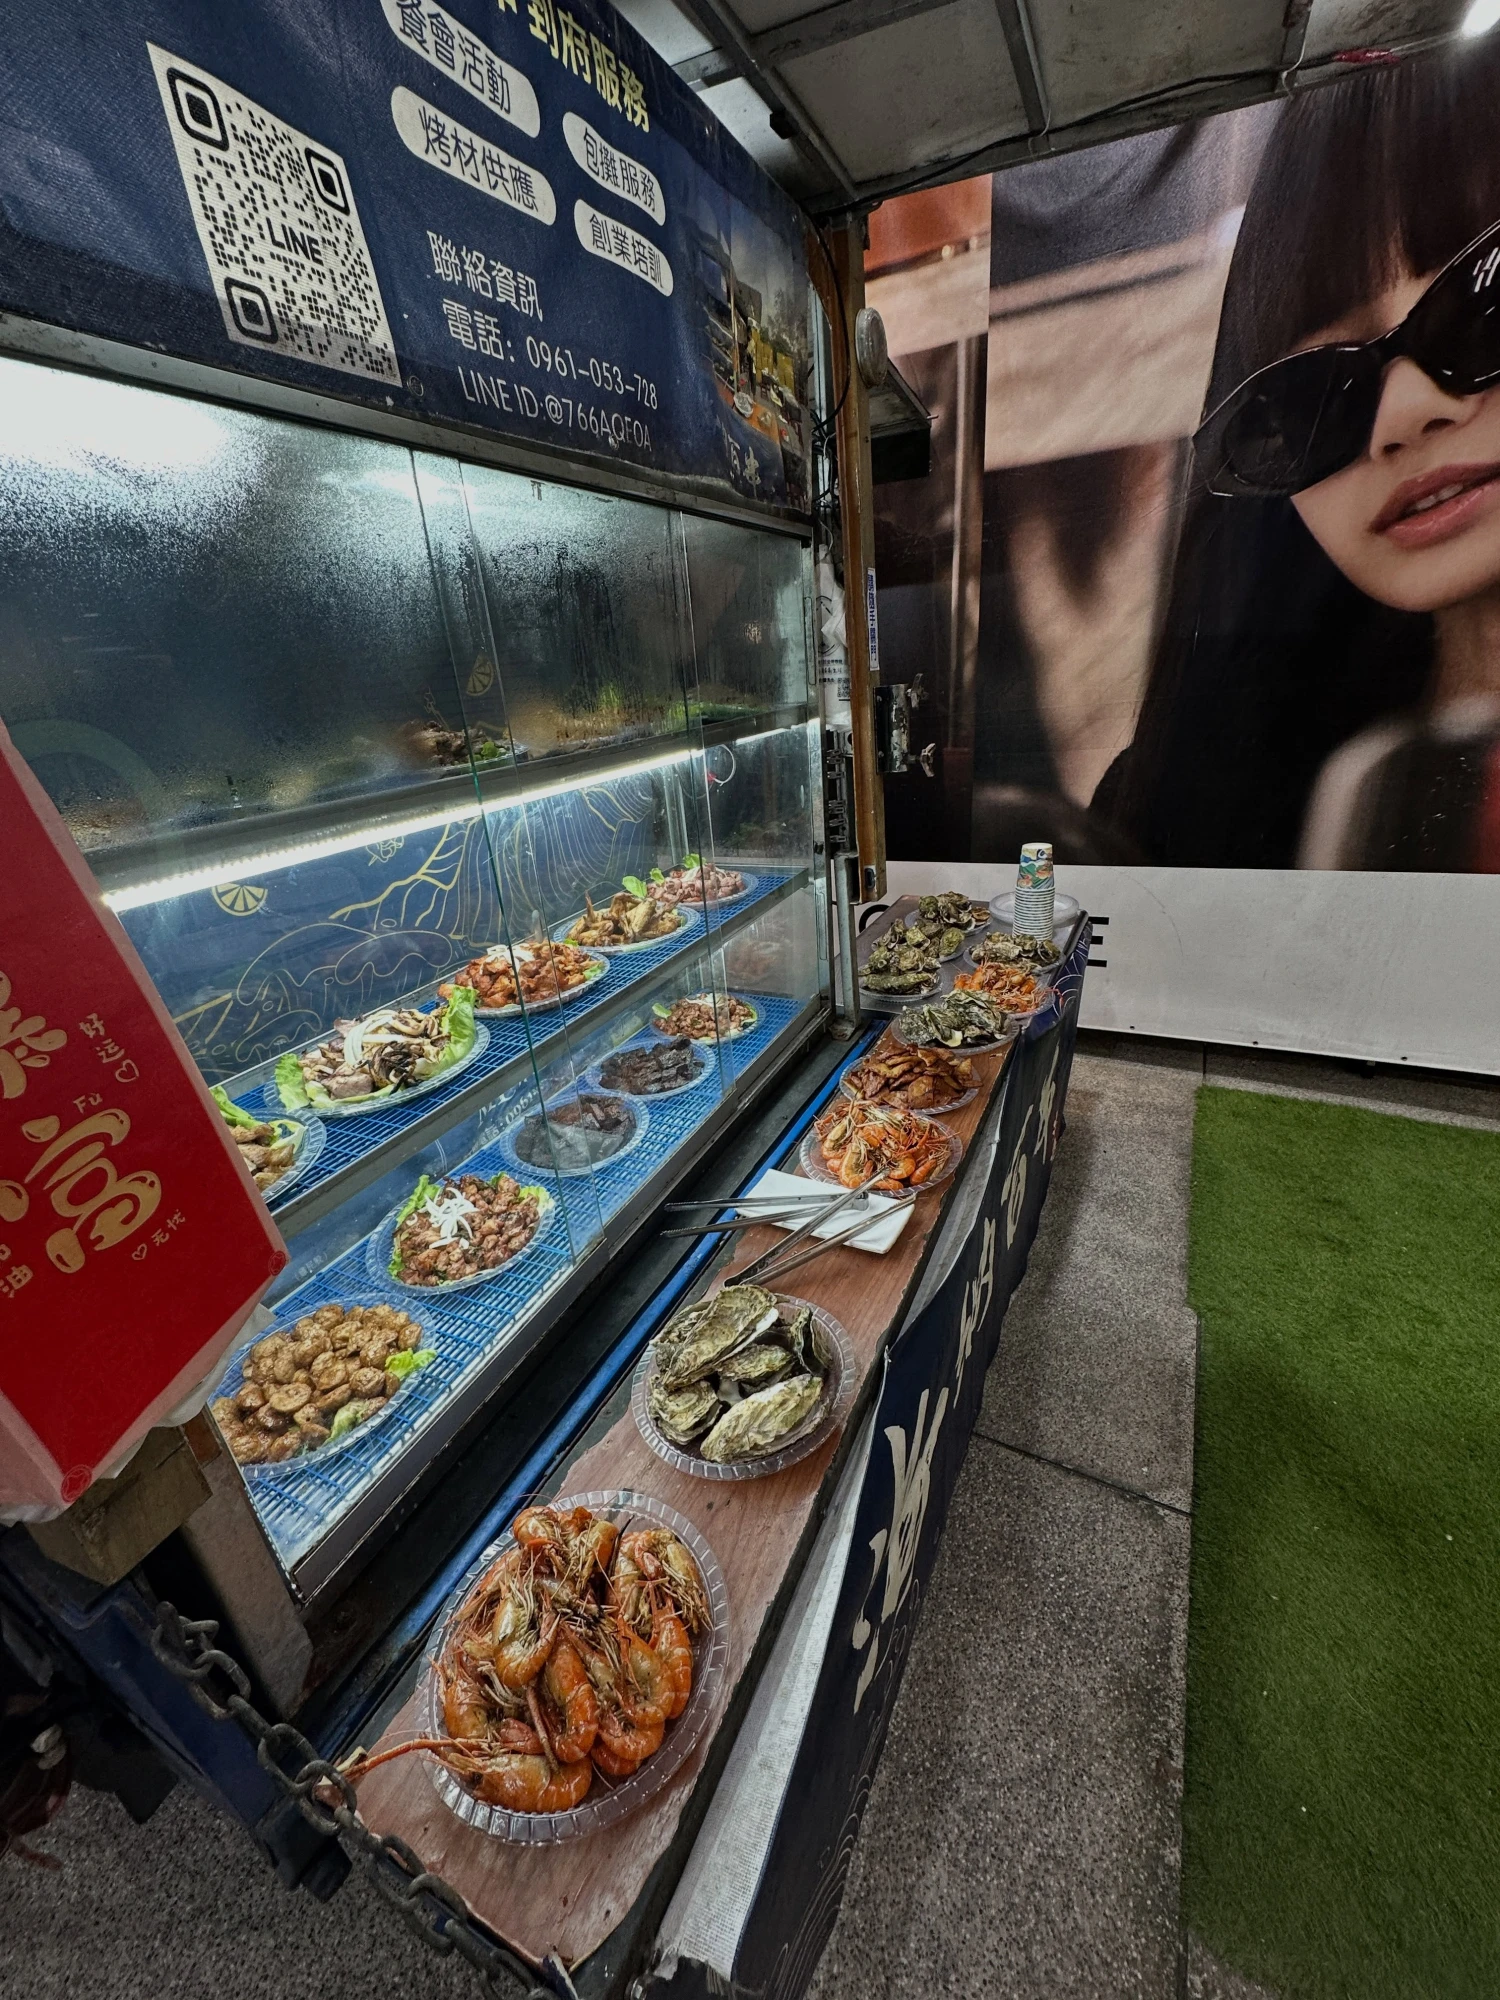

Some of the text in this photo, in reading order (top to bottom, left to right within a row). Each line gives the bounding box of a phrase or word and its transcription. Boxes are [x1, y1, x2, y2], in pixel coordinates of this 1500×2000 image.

[418, 105, 539, 213] 烤材供應
[583, 127, 656, 213] 包攤服務
[266, 218, 323, 265] LINE
[588, 213, 664, 288] 創業培訓
[426, 230, 543, 322] 聯絡資訊
[458, 365, 513, 412] LINE
[79, 1012, 125, 1064] 好运
[151, 1209, 186, 1247] 无忧
